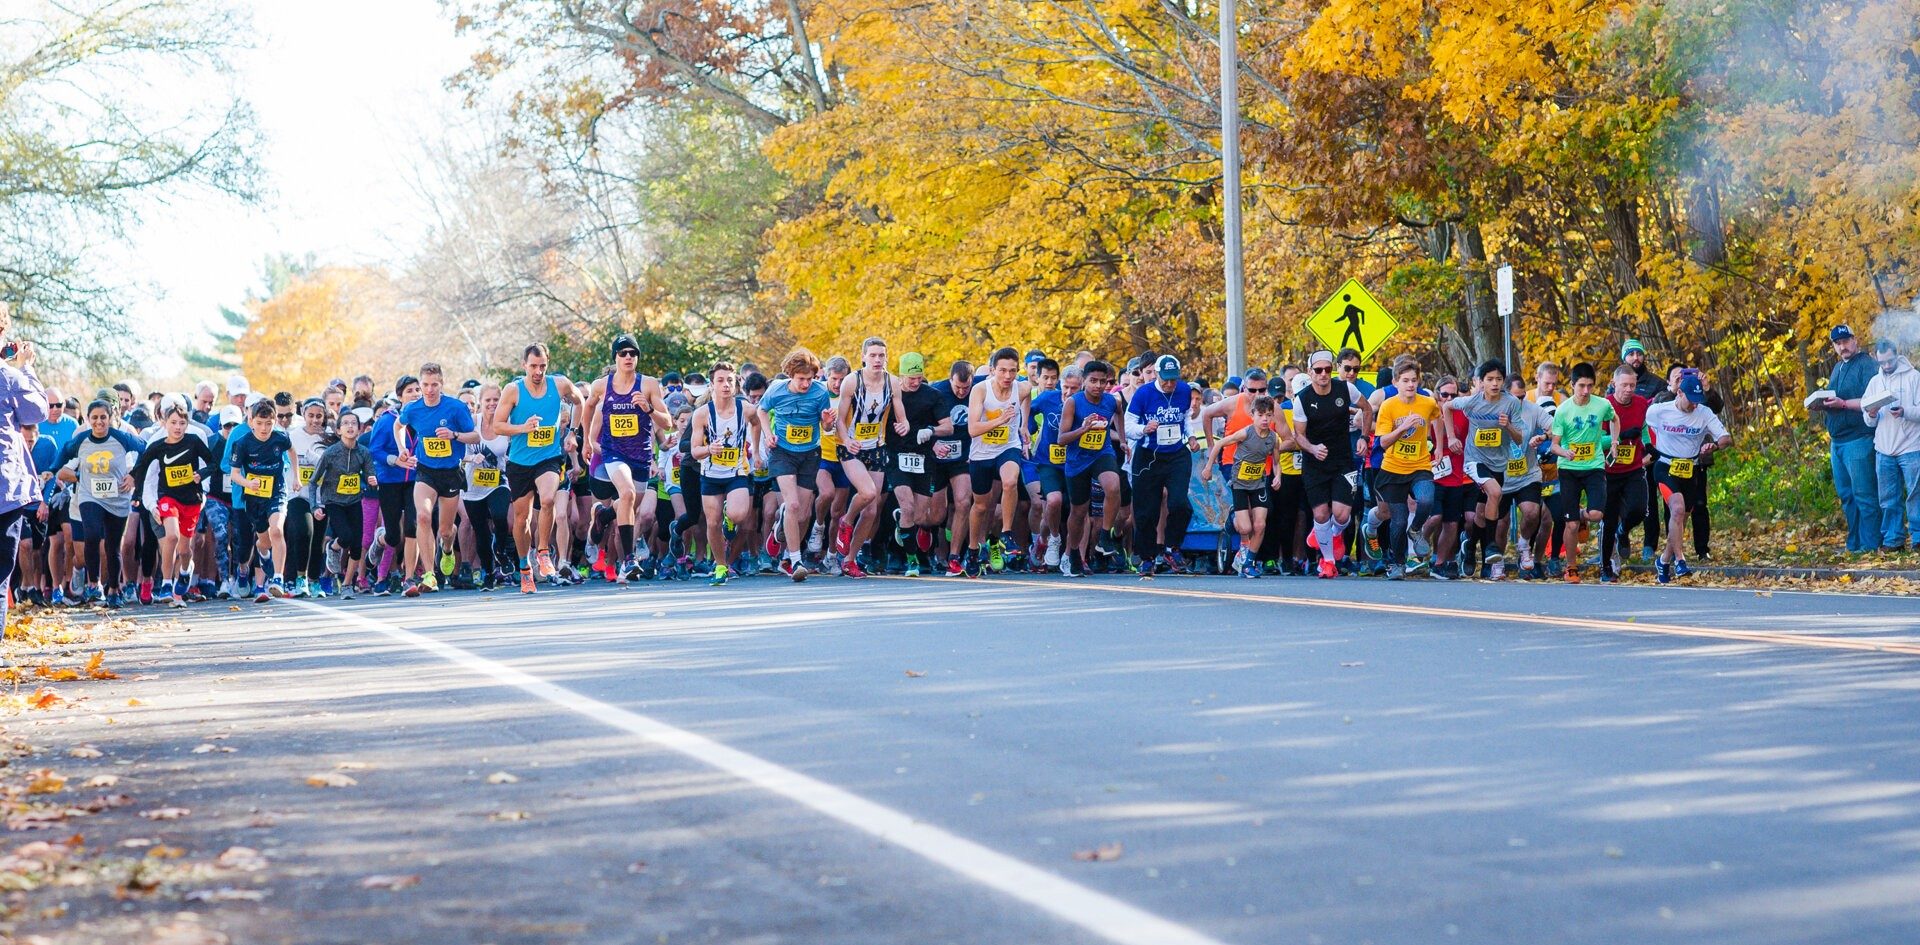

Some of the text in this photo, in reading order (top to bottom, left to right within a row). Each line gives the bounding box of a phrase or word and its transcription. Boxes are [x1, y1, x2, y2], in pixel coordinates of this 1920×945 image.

[615, 420, 633, 428] 825
[792, 429, 808, 437] 525
[1168, 429, 1171, 437] 1
[1664, 425, 1684, 433] TEAM
[534, 431, 550, 439] 896
[1086, 434, 1102, 442] 519
[429, 441, 446, 450] 829
[1399, 444, 1416, 453] 769
[1575, 446, 1590, 454] 733
[904, 457, 920, 466] 116
[171, 470, 188, 478] 692
[1245, 466, 1261, 474] 850
[96, 483, 112, 491] 307
